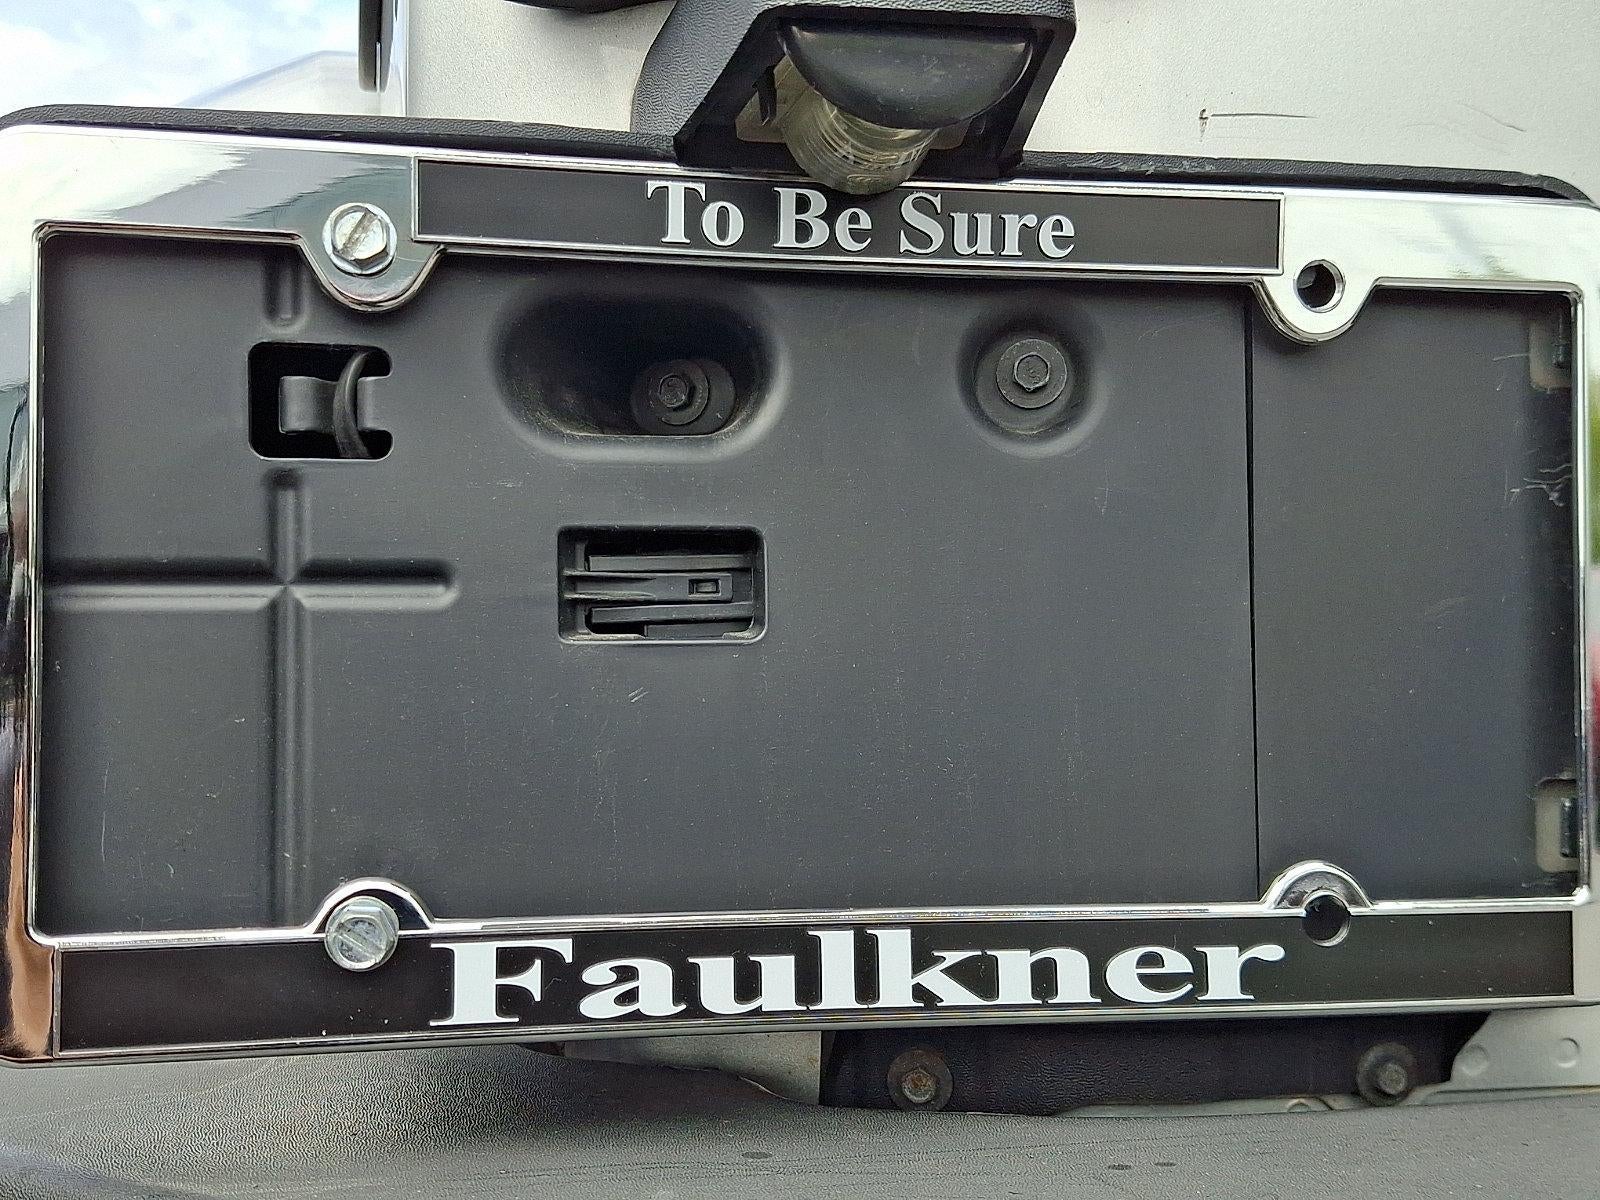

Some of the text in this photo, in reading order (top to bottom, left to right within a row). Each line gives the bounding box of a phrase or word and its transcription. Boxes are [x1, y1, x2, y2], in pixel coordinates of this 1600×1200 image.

[645, 179, 1077, 258] To Be Sure
[428, 928, 1286, 1027] Faulkner
